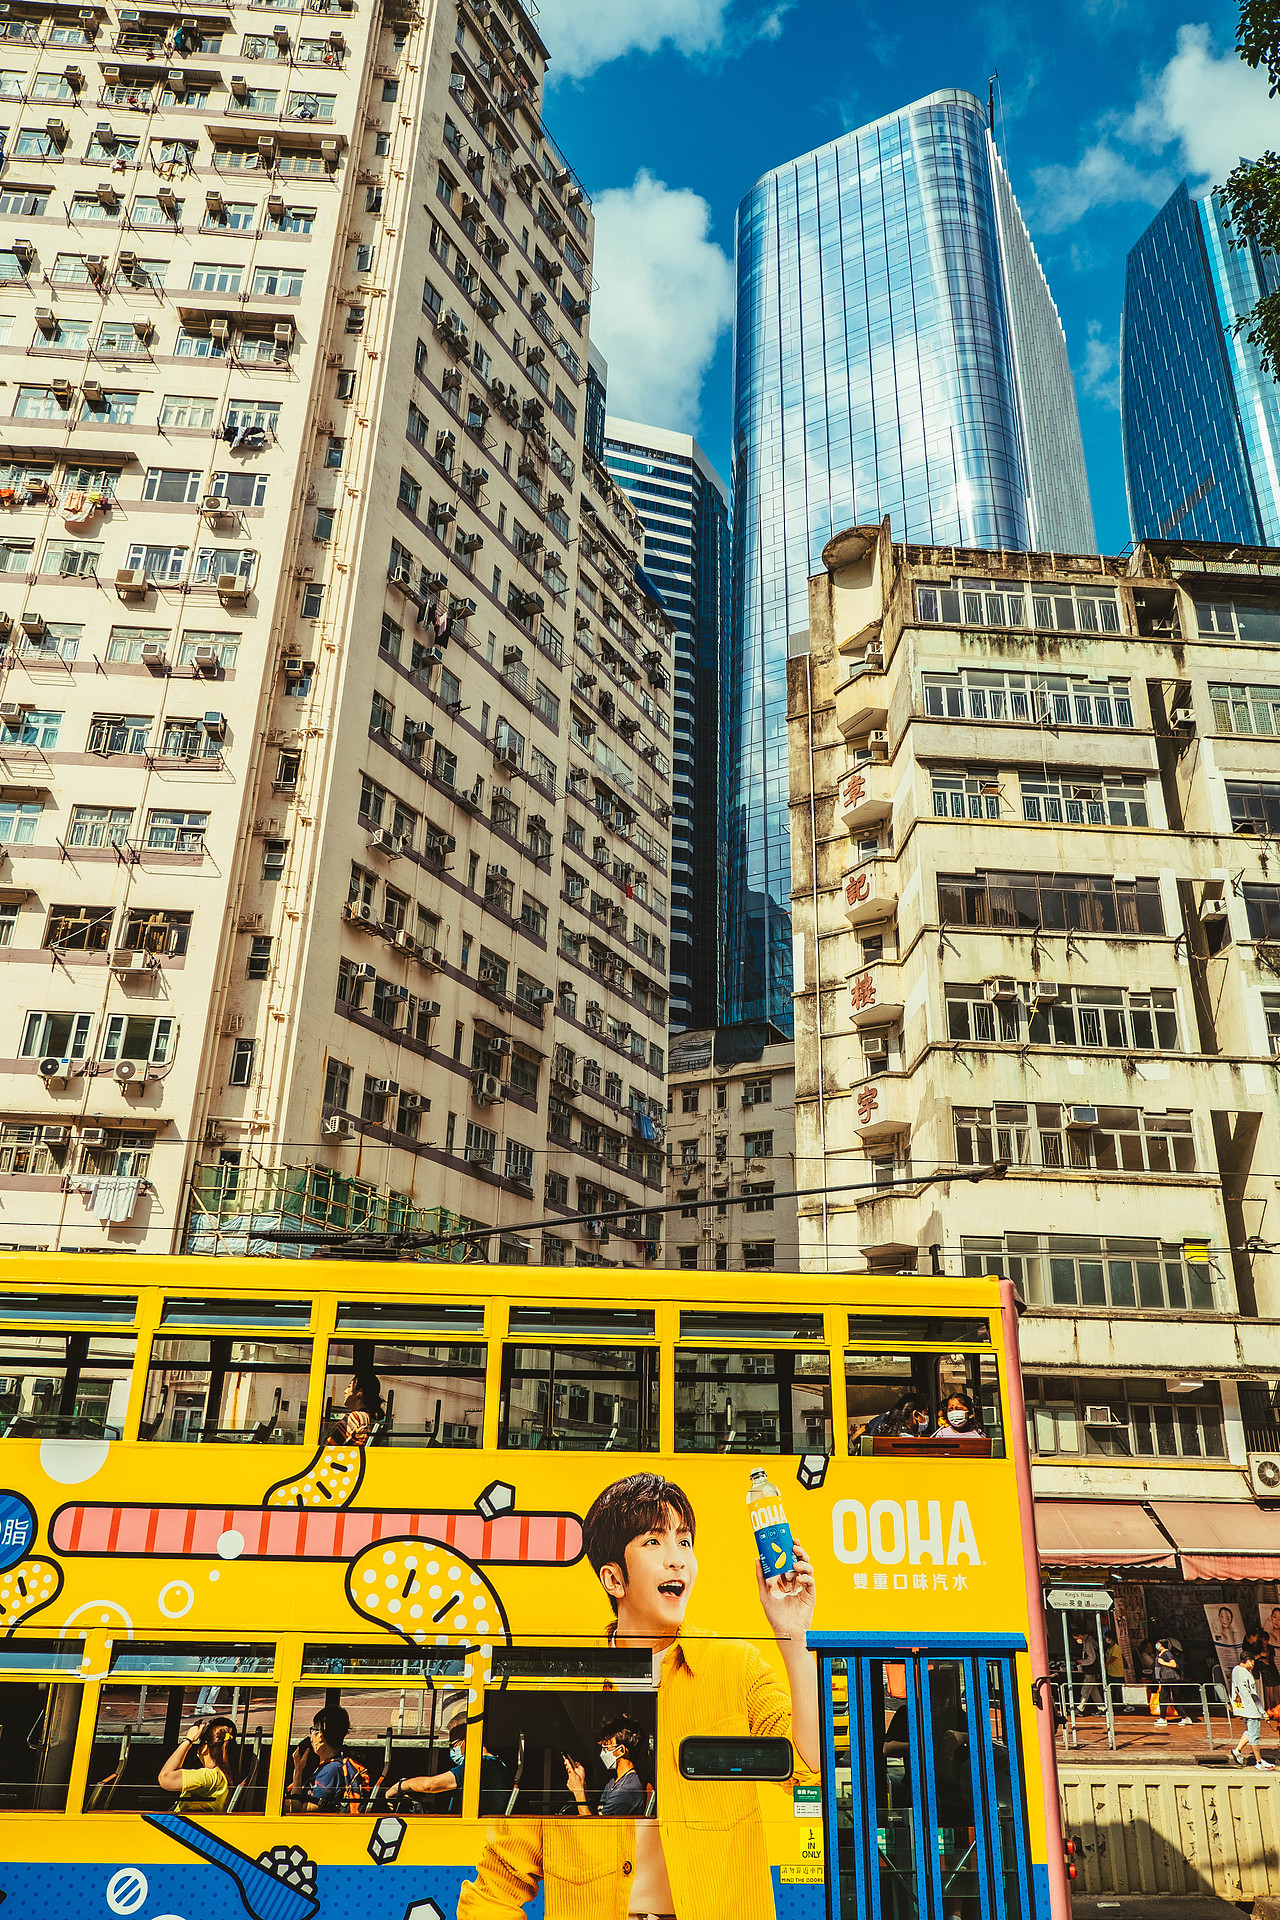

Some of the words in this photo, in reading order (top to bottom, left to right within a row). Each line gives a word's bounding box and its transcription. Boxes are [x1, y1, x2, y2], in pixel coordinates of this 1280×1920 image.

[751, 1503, 788, 1532] OOHA
[0, 1518, 29, 1546] 脂
[832, 1499, 982, 1566] OOHA
[853, 1572, 969, 1591] 雙重口味汽水
[801, 1850, 822, 1859] ONLY
[807, 1842, 816, 1850] IN
